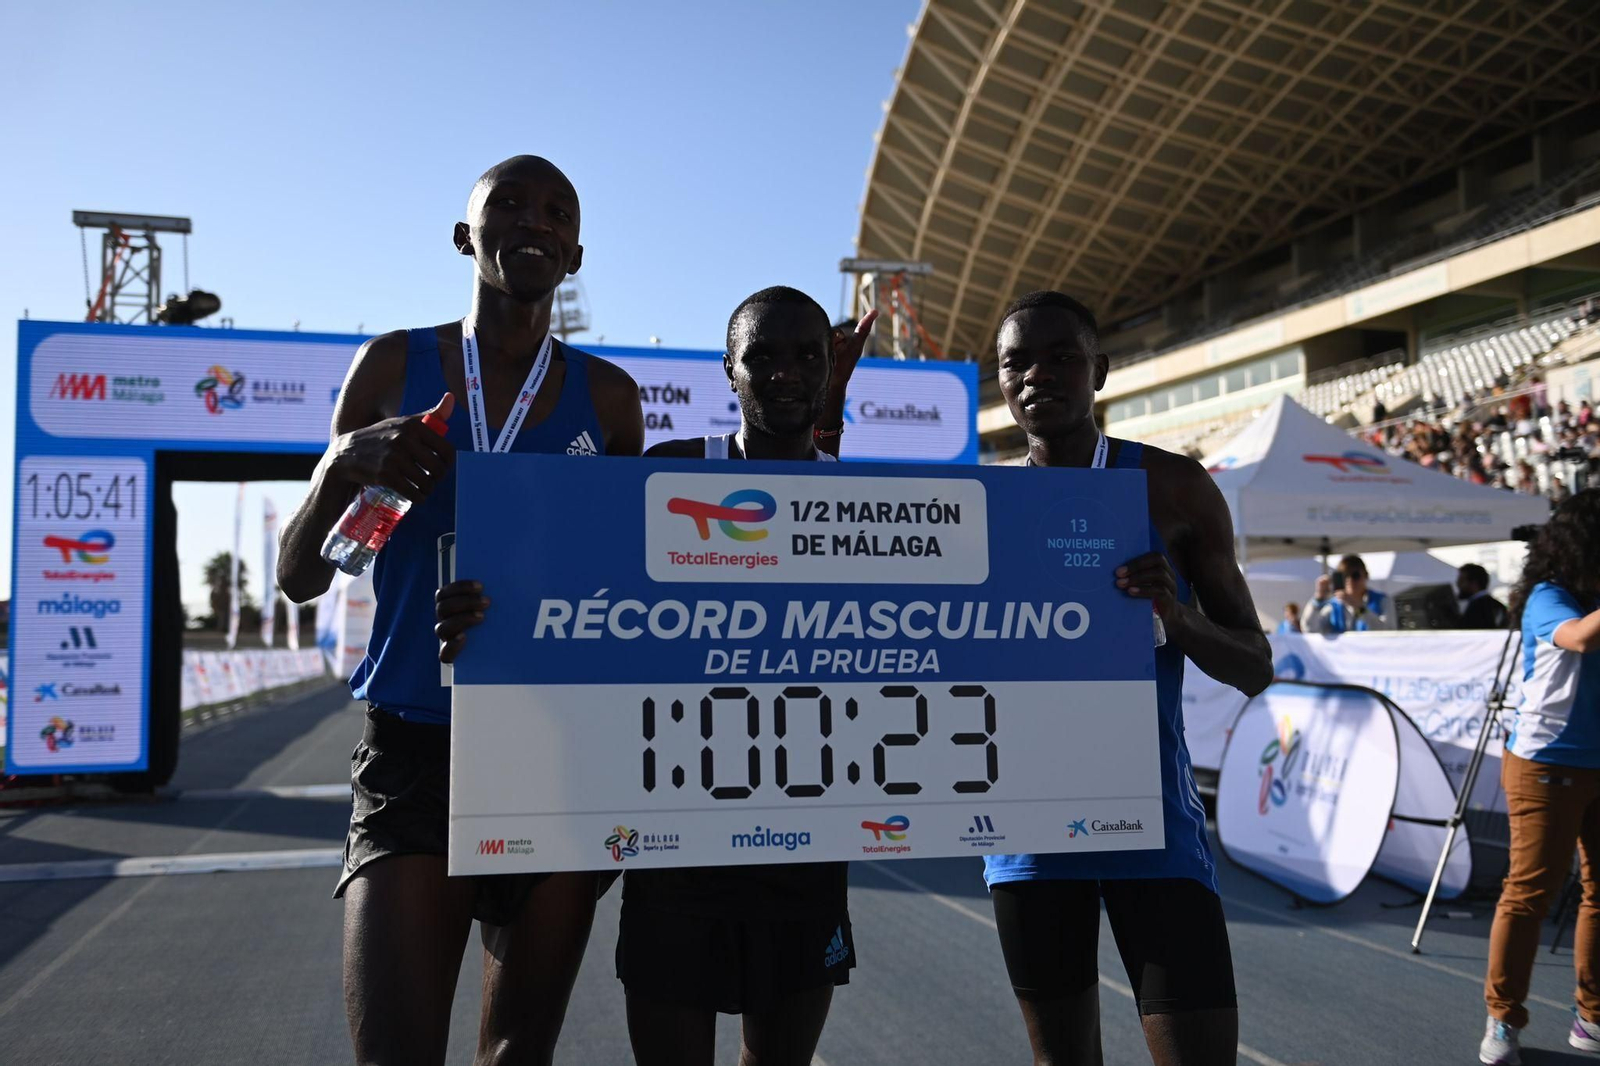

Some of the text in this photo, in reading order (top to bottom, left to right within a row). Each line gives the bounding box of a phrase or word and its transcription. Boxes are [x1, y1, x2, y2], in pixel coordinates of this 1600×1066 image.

[112, 375, 161, 388] metro
[640, 382, 690, 405] ATÓN
[860, 401, 942, 422] CaixaBank
[26, 472, 137, 520] 1:05:41
[790, 497, 961, 525] 1/2 MARATÓN
[1070, 518, 1088, 533] 13
[791, 530, 943, 557] DE MÁLAGA
[1047, 536, 1116, 550] NOVIEMBRE
[667, 550, 779, 569] TotalEnergies
[1064, 552, 1101, 567] 2022
[532, 587, 1091, 641] RÉCORD MASCULINO
[704, 648, 941, 675] DE LA PRUEBA
[642, 684, 999, 800] 1:00:23
[1091, 819, 1144, 833] CaixaBank
[507, 838, 532, 846] metro
[643, 833, 680, 844] MÁLAGA
[507, 845, 534, 855] Málaga
[862, 845, 911, 854] TotalEnergies
